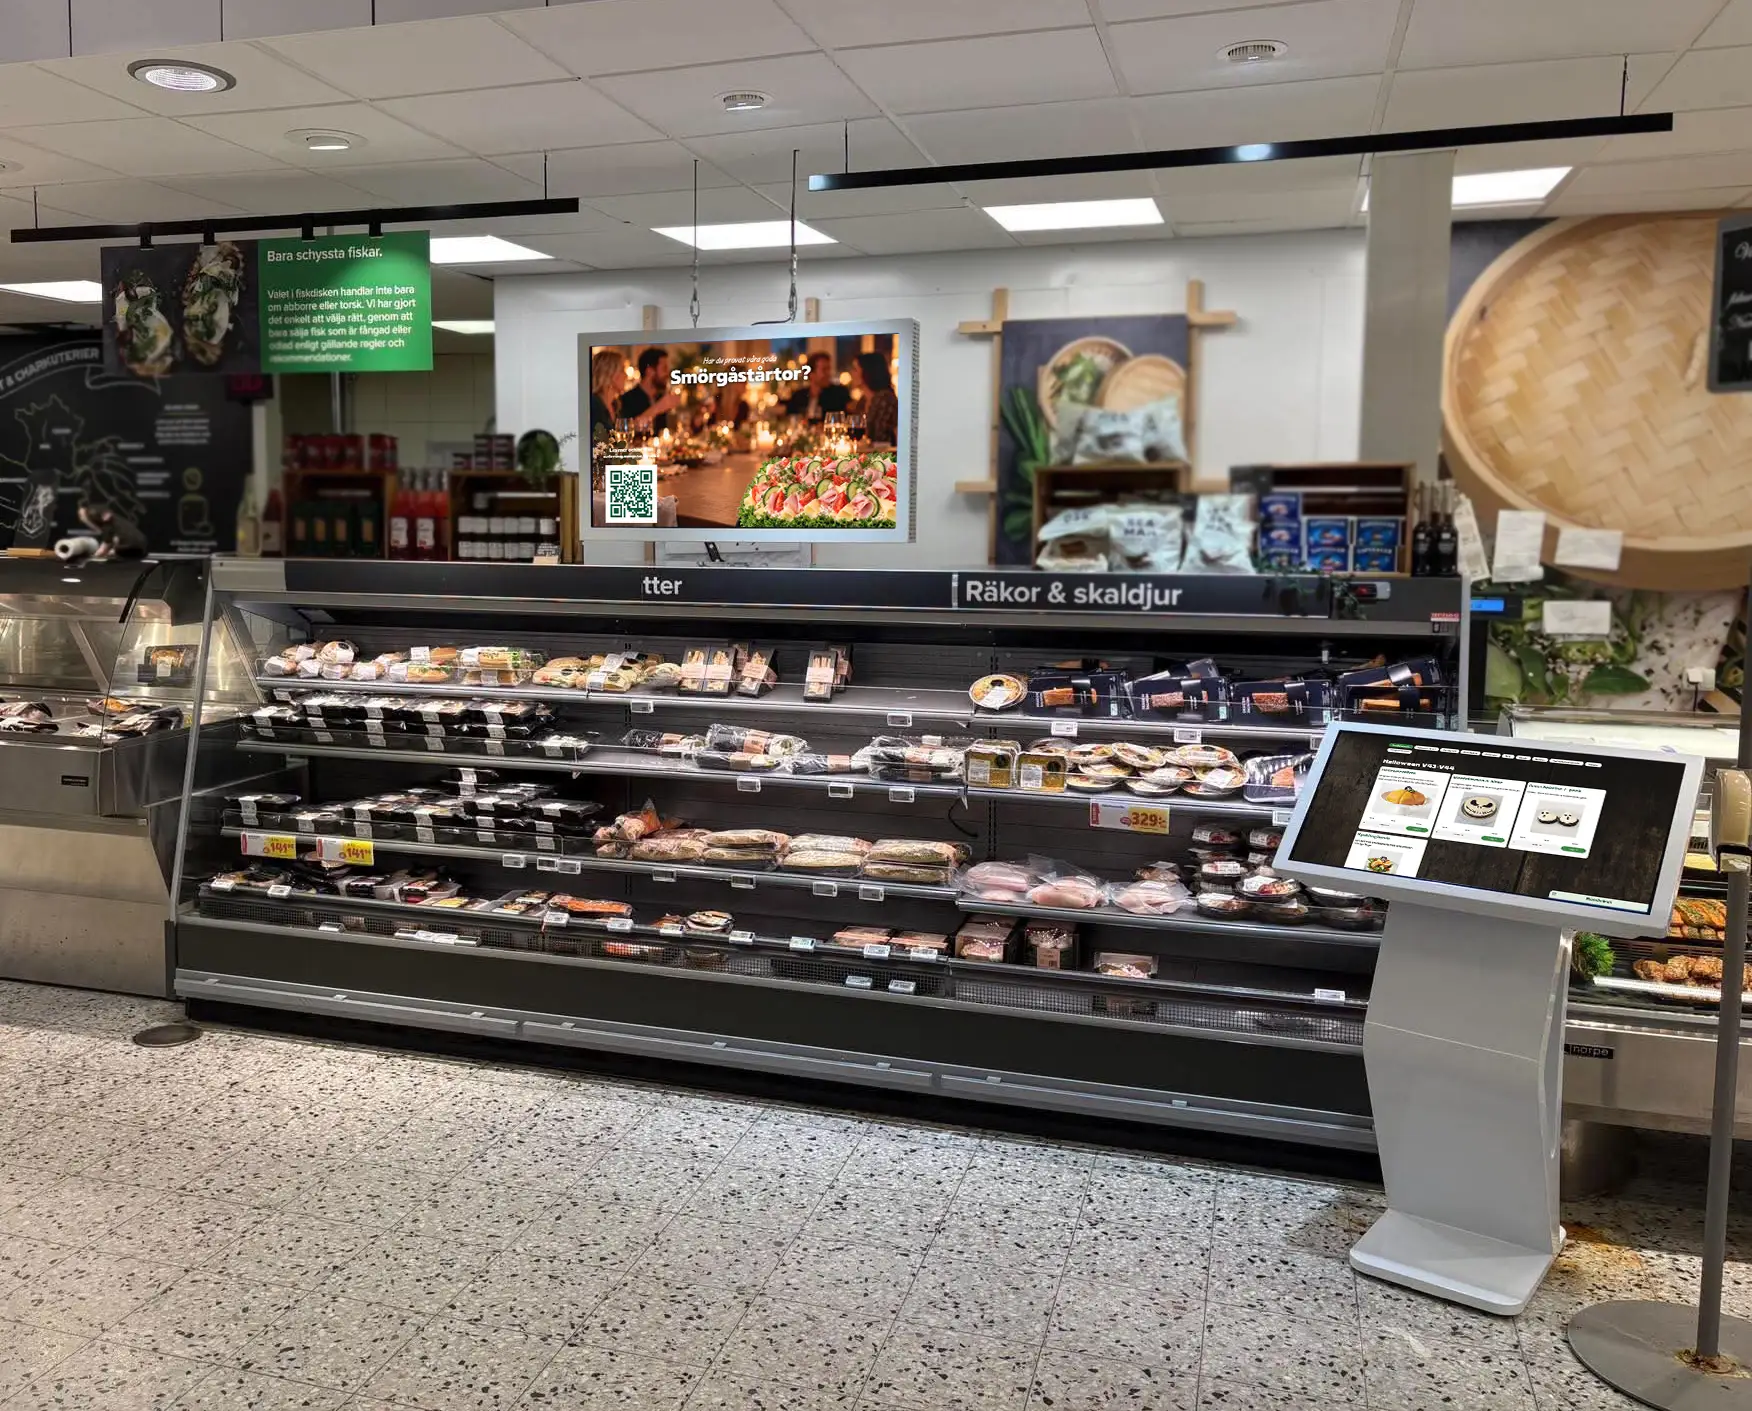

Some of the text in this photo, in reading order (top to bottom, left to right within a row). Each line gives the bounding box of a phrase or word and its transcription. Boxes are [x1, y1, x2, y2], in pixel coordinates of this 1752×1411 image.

[267, 245, 383, 263] Bara schyssta fiskar.
[267, 289, 290, 299] Valet
[295, 287, 339, 298] fiskdisken
[340, 286, 374, 297] handlar
[375, 285, 393, 296] inte
[394, 284, 415, 295] bara
[268, 298, 416, 312] om abborre eller torsk. Vi har gjort
[268, 311, 413, 325] det enkelt att välja rätt, genom att
[268, 324, 412, 339] bara sälja fisk som är fångad eller
[269, 338, 405, 352] odlad enligt gällande regler och
[723, 356, 746, 366] provat
[670, 365, 812, 387] Smörgåstårtor?
[642, 576, 683, 595] tter
[965, 580, 1183, 611] Räkor & skaldjur
[1382, 759, 1421, 768] Halloween
